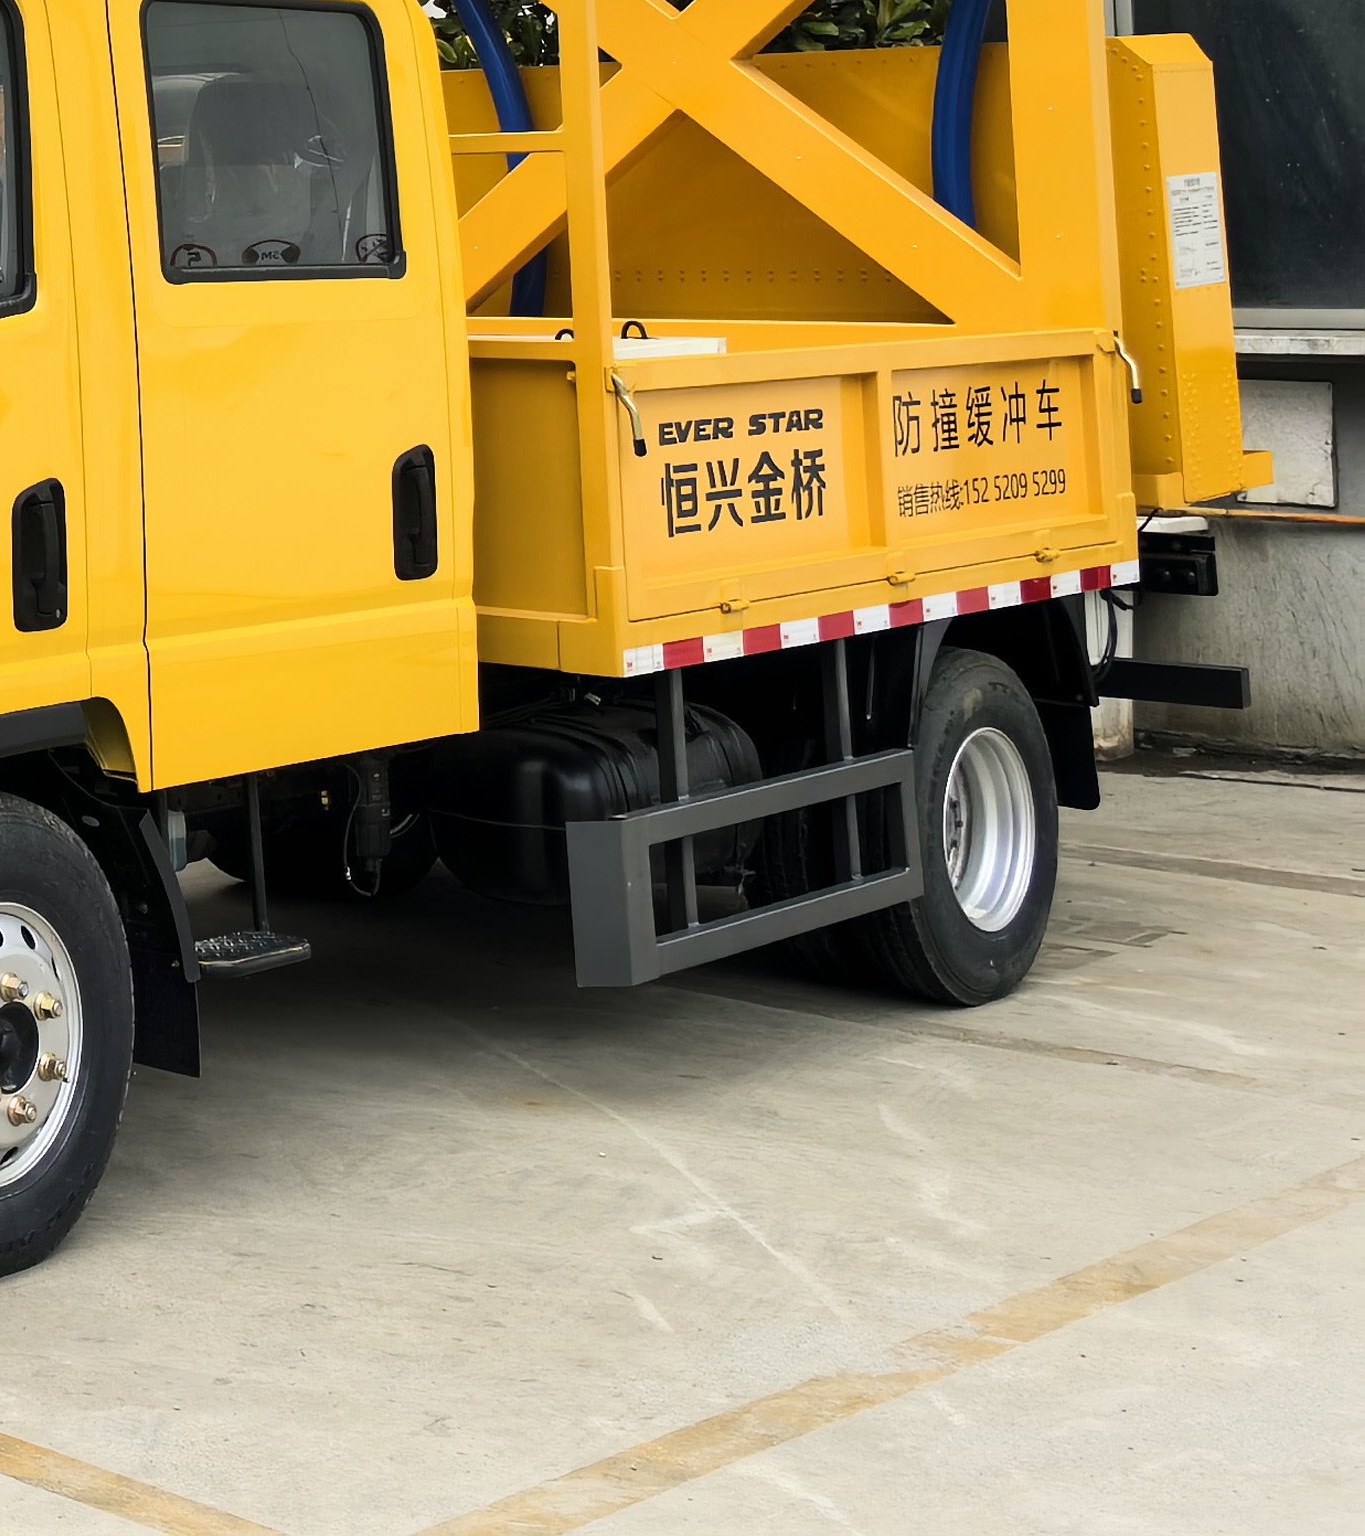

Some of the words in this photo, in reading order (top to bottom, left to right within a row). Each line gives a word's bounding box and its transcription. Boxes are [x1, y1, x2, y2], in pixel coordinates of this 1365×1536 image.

[658, 417, 734, 446] EVER
[748, 408, 824, 434] STAR
[892, 379, 1063, 457] 防撞缓冲车
[660, 448, 827, 537] 恒兴金桥
[993, 472, 1028, 501] 5209
[1032, 468, 1066, 496] 5299
